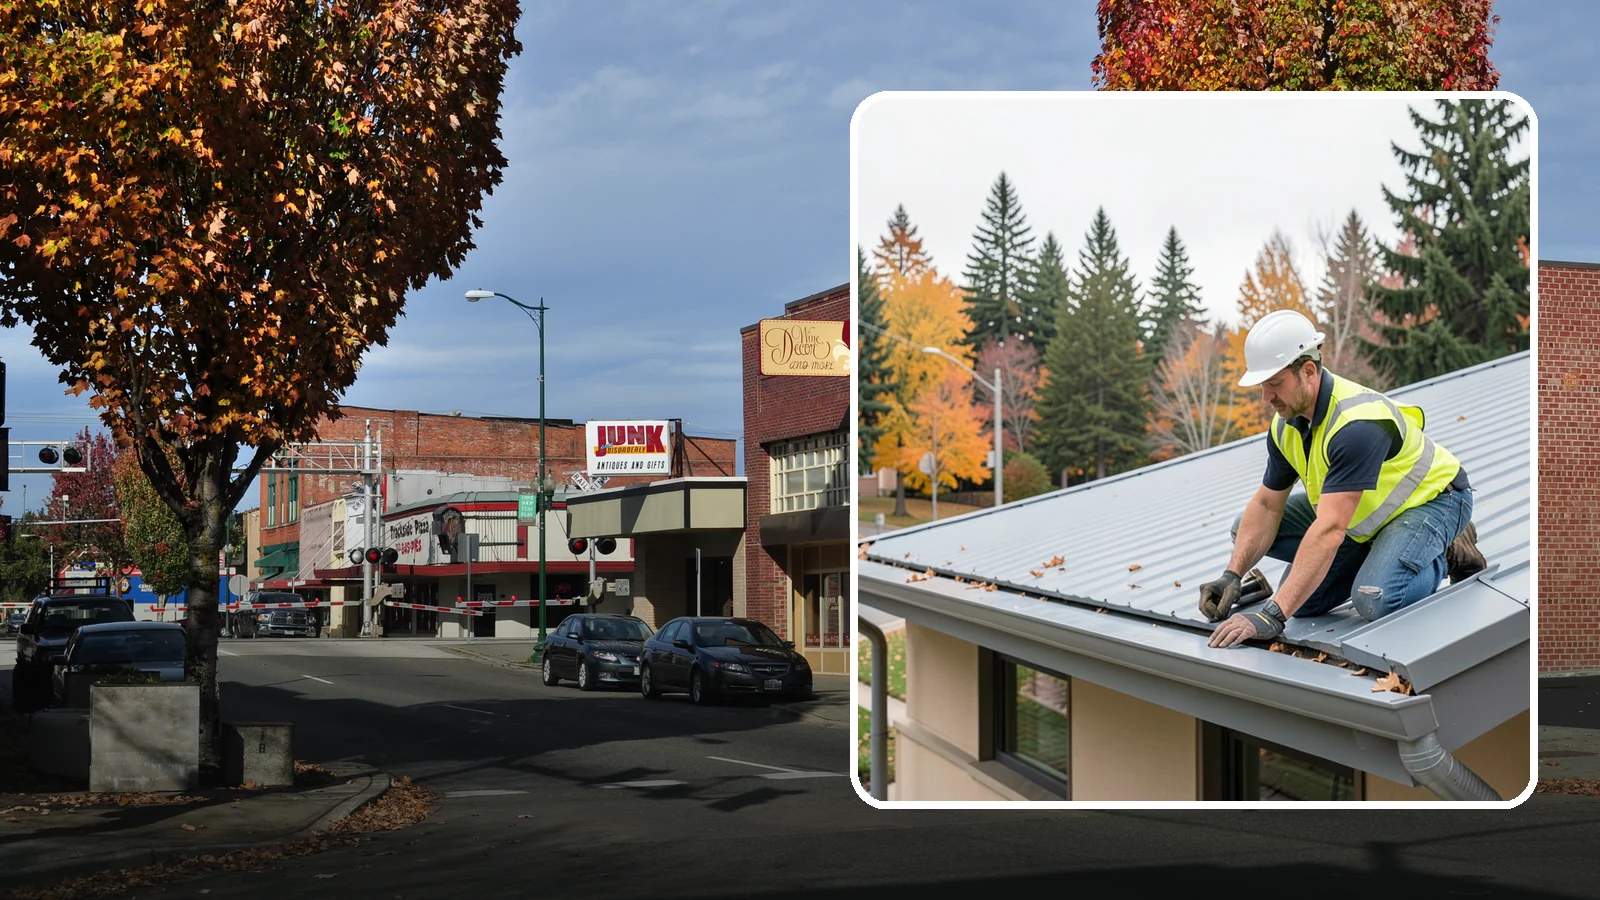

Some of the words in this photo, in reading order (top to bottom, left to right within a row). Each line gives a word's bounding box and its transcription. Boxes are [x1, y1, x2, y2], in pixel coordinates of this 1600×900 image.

[595, 425, 666, 457] JUNK
[607, 446, 646, 454] DISORDERLY
[596, 461, 628, 470] ANTIQUES
[631, 461, 644, 470] AND
[647, 460, 665, 469] GIFTS
[414, 519, 429, 534] Pizza
